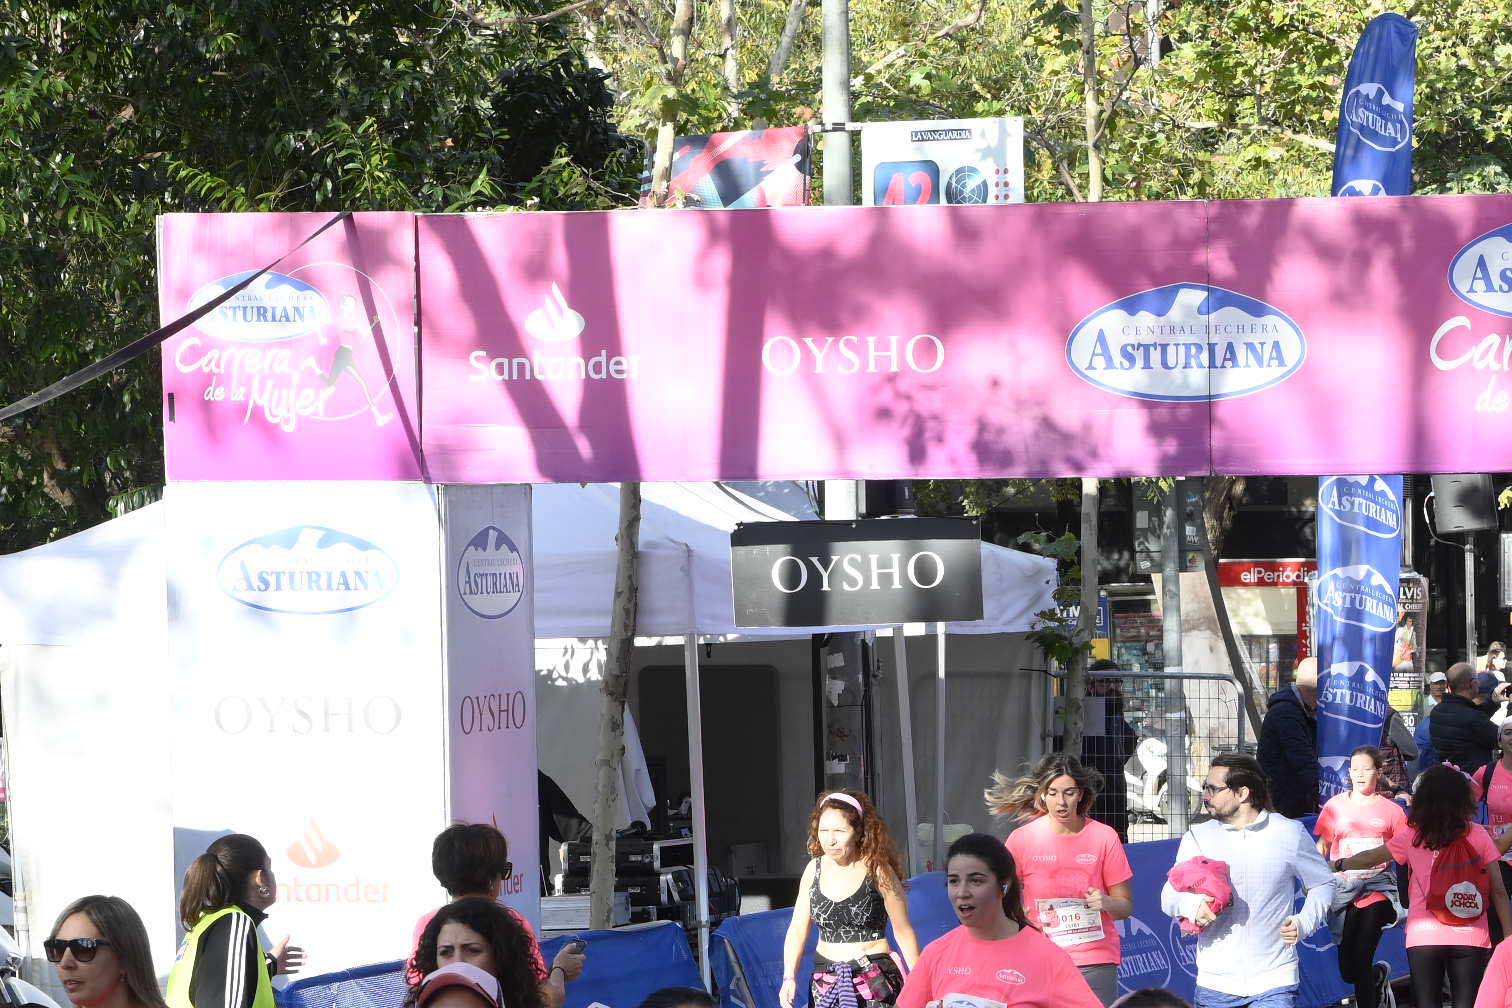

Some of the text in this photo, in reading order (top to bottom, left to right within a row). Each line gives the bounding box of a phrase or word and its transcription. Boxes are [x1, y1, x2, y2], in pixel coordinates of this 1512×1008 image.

[922, 129, 970, 140] VANGUARDIA
[1122, 322, 1279, 335] CENTRAL LECHERA
[175, 337, 292, 374] Carrera
[468, 350, 640, 380] Santander
[761, 334, 945, 376] OYSHO
[1085, 328, 1288, 371] ASTURIANA
[243, 366, 336, 432] Mujer
[1475, 372, 1509, 412] de
[1328, 485, 1397, 529] ASTURIANA
[462, 560, 521, 596] ASTURIANA
[771, 551, 945, 594] OYSHO
[1323, 581, 1395, 624] ASTURIANA
[1400, 587, 1423, 600] LVIS
[214, 694, 402, 736] OYSHO
[460, 690, 526, 736] OYSHO
[1450, 899, 1479, 910] SCHOOL
[1453, 891, 1478, 901] TODAY
[1061, 912, 1081, 922] 016
